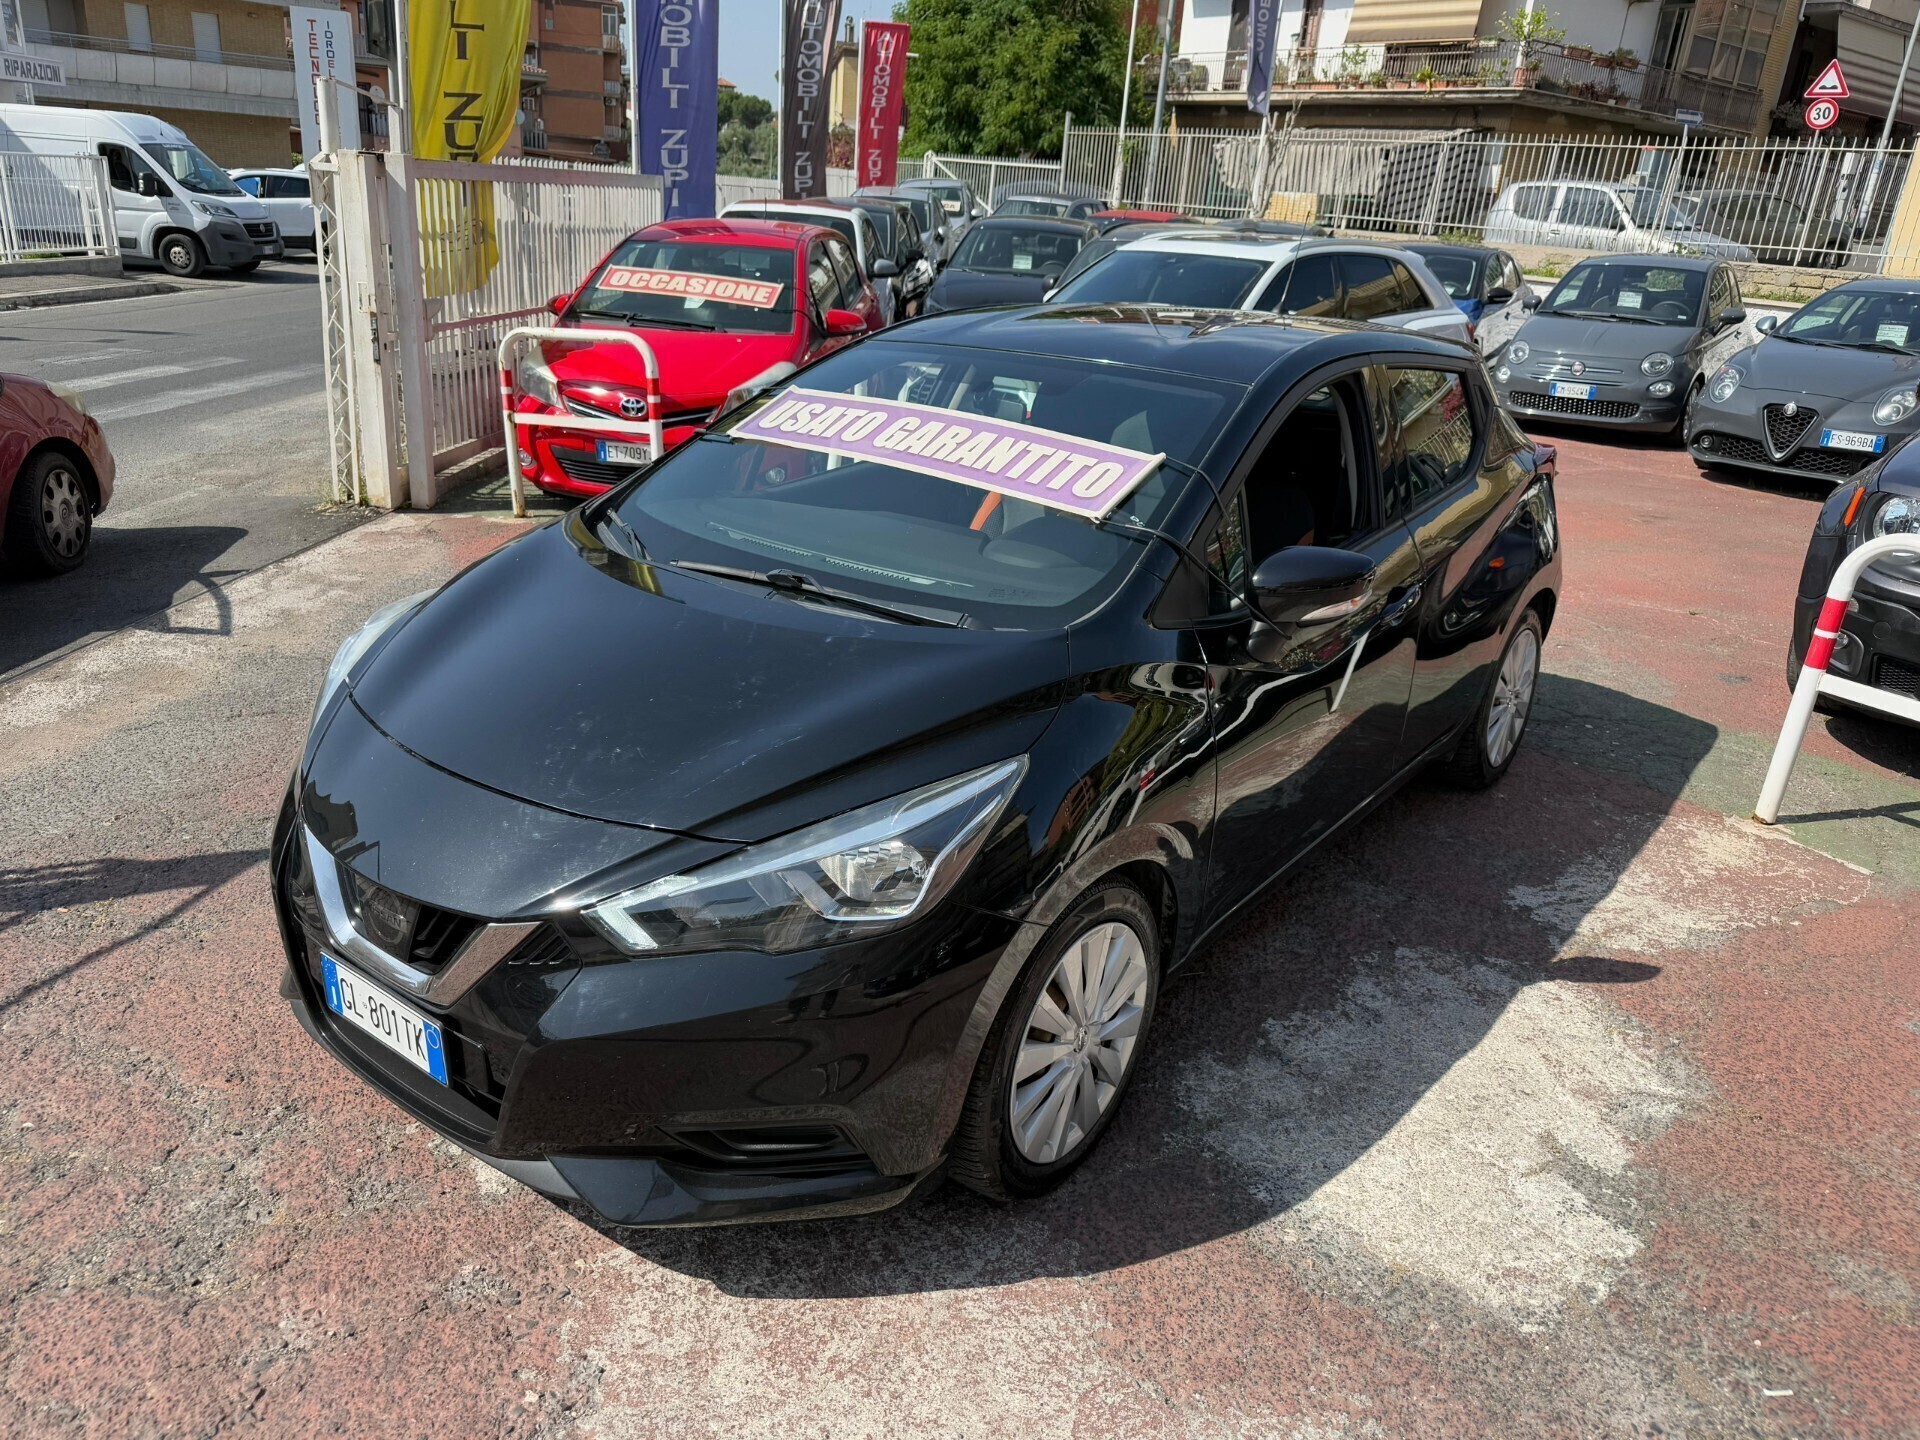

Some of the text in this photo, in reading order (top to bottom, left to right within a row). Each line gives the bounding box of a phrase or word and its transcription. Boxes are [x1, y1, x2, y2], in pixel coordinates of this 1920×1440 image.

[3, 57, 62, 83] RIPARAZIONI
[659, 0, 692, 207] OBILI ZUPI
[1813, 106, 1831, 121] 30
[609, 271, 773, 303] OCCASIONE
[623, 446, 651, 461] 709Y
[757, 400, 1125, 498] USATO GARANTITO
